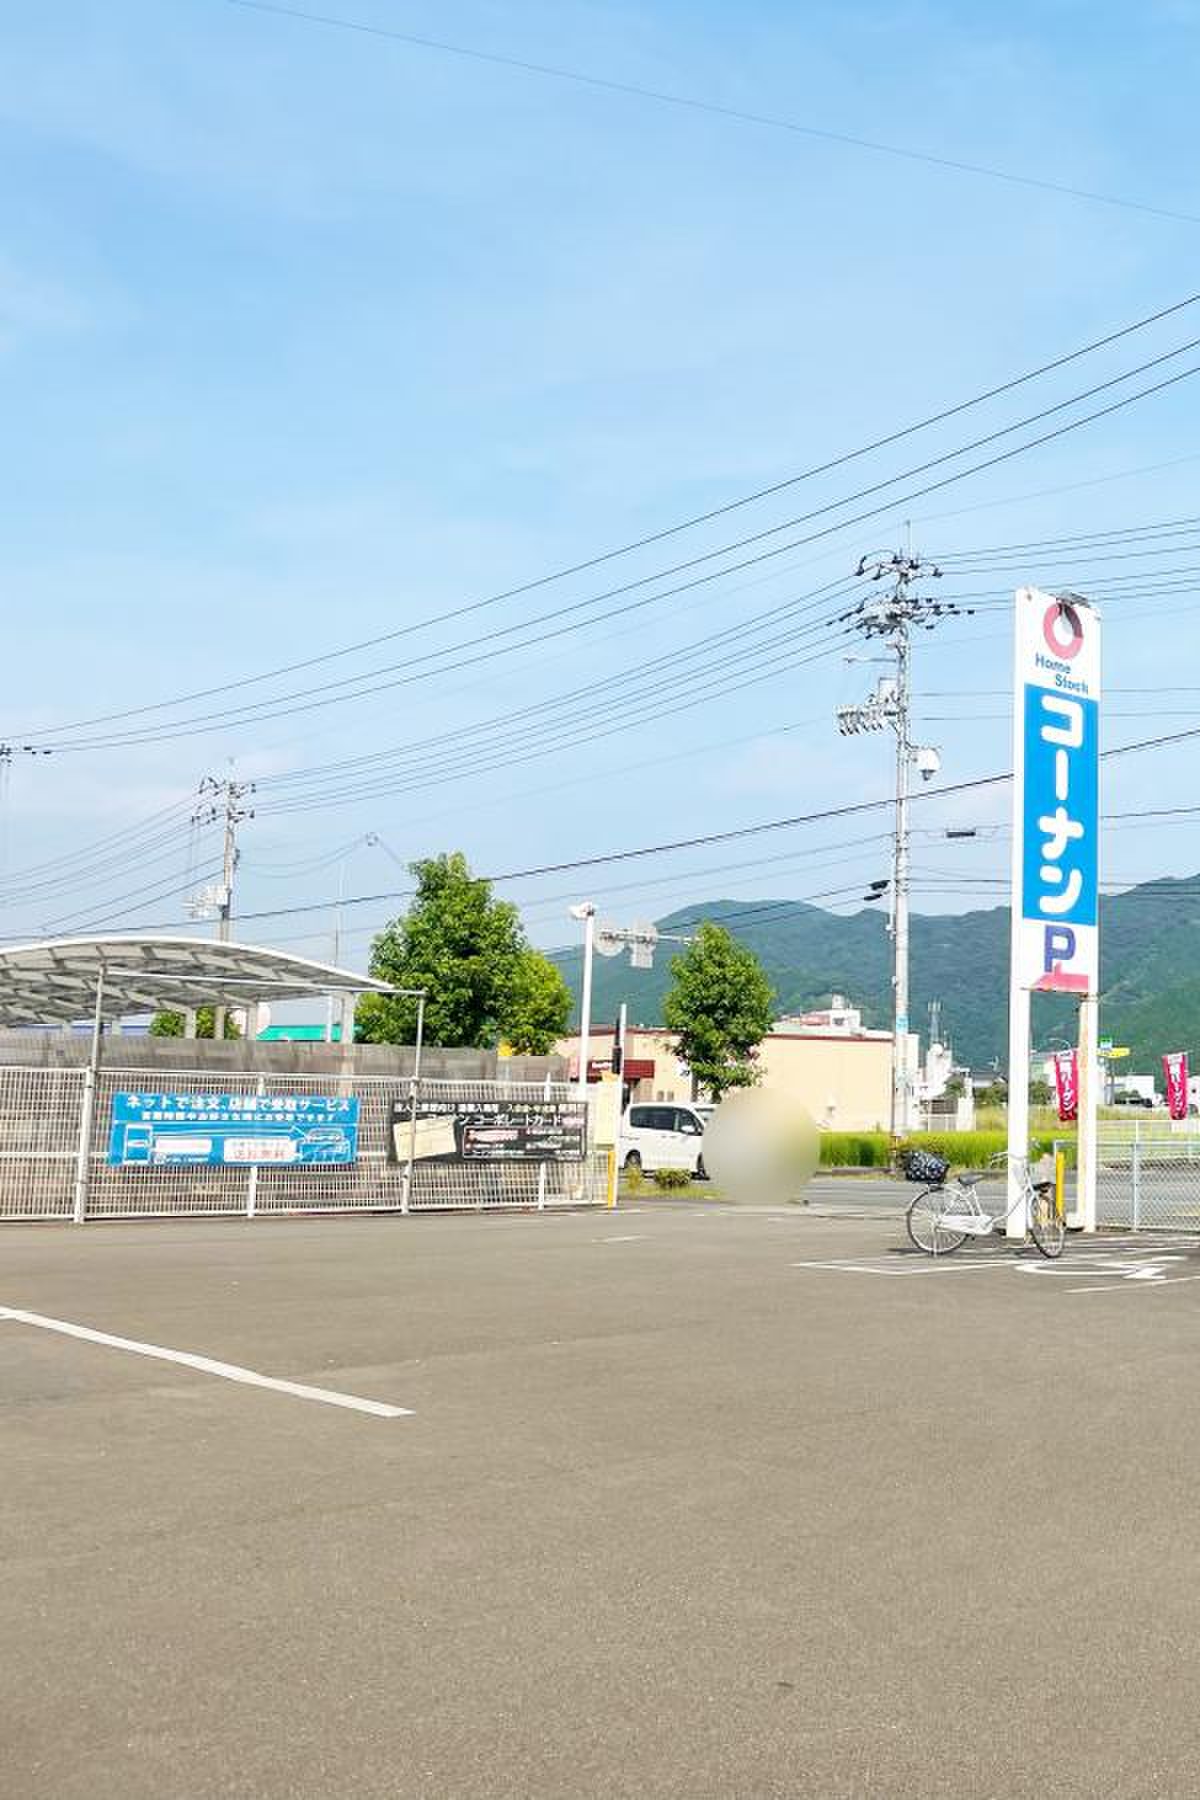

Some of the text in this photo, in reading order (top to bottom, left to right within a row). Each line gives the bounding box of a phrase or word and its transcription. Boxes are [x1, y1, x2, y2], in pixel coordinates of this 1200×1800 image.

[1035, 652, 1071, 674] Home
[1037, 694, 1084, 915] コーナン
[1044, 924, 1076, 973] P
